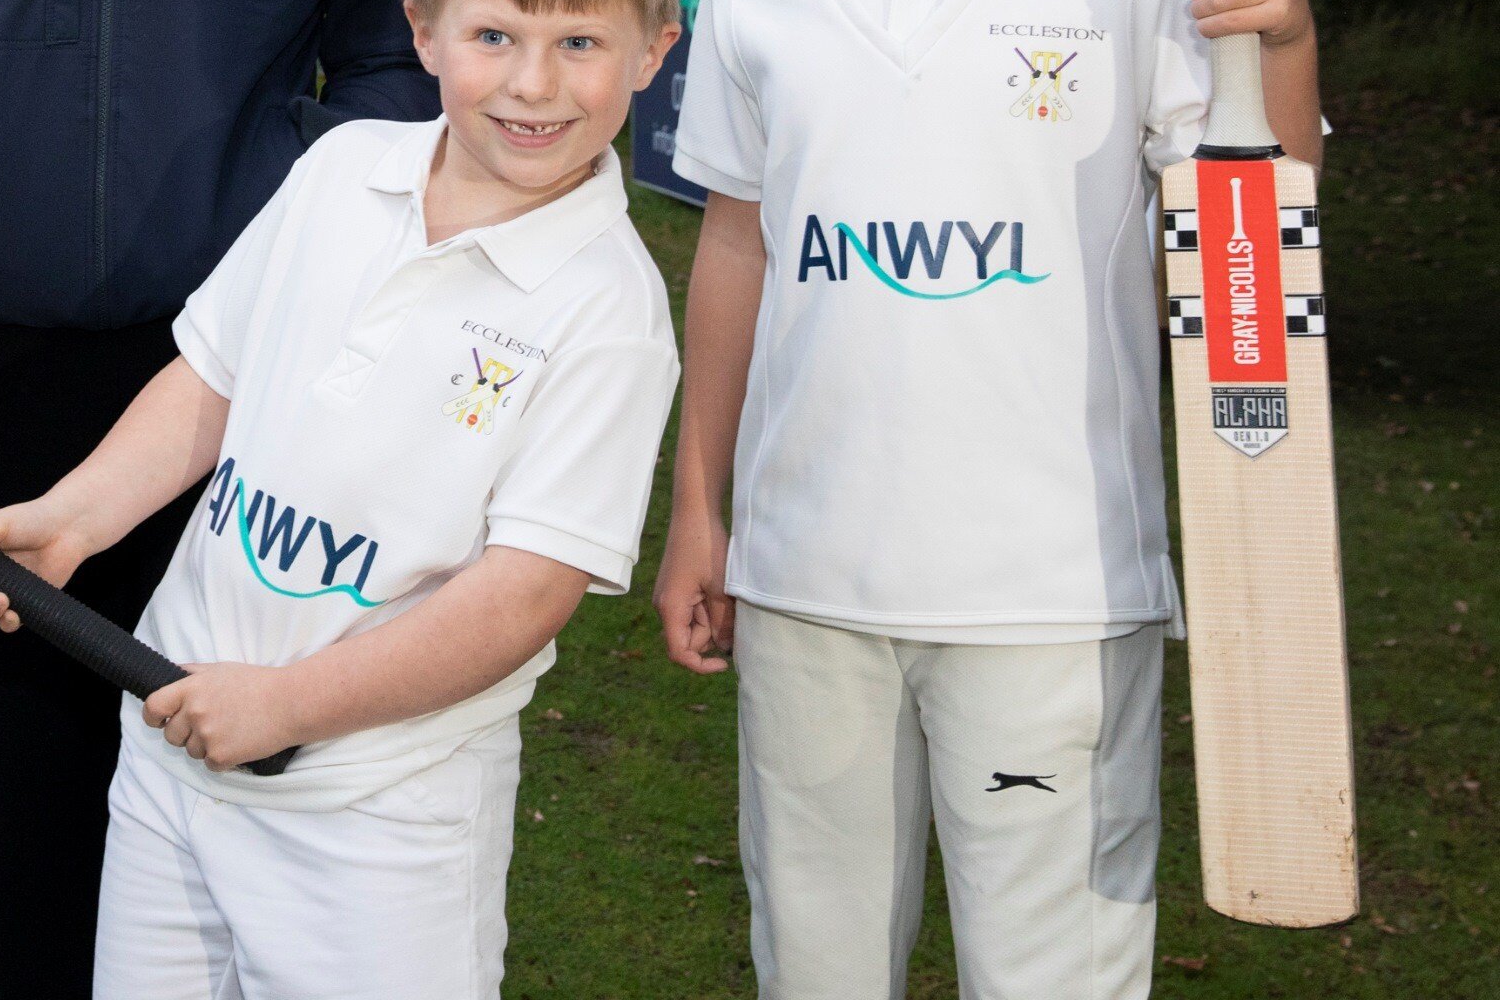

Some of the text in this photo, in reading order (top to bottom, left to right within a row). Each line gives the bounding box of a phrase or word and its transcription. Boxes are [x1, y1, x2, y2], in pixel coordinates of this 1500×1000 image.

[989, 24, 1106, 41] ECCLESTON
[797, 214, 1052, 300] ANWYL
[1226, 240, 1261, 365] GRAY-NICOLLS
[1214, 397, 1286, 427] ALPHA
[1233, 431, 1251, 442] GEN
[209, 457, 389, 608] ANWYL
